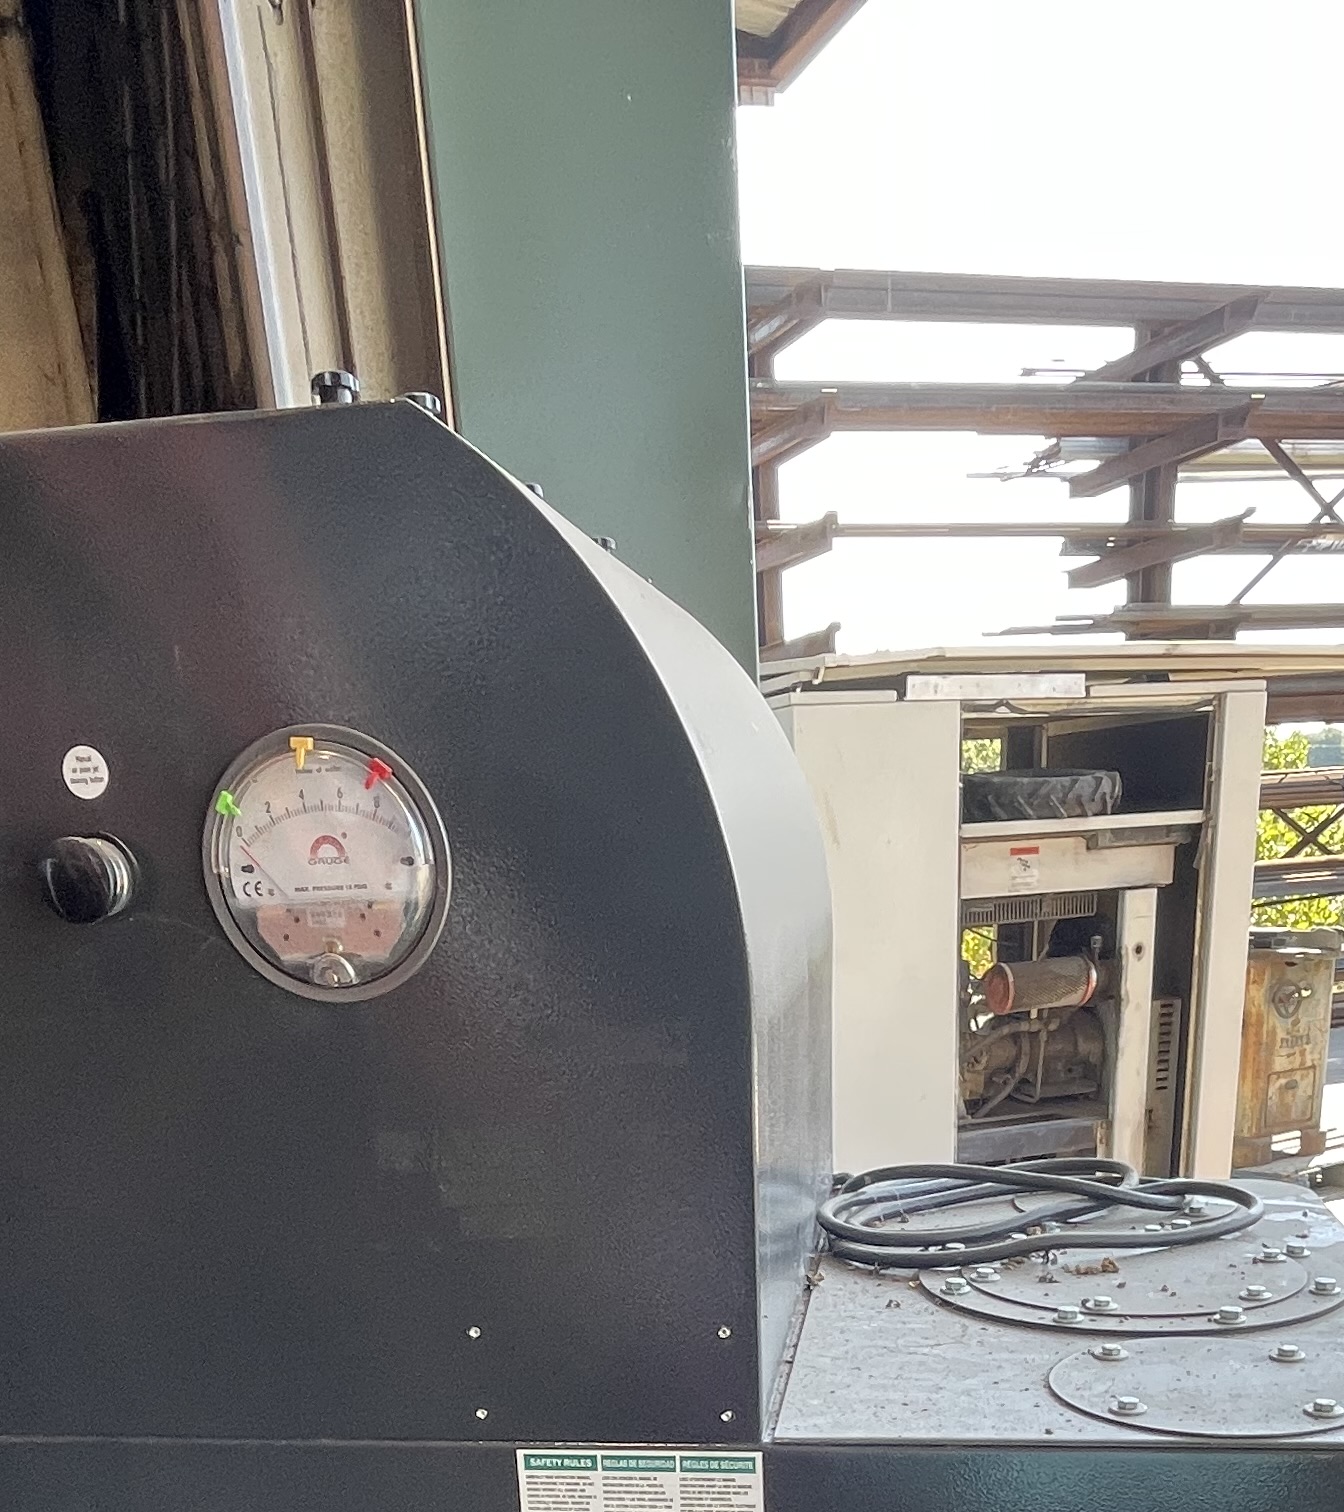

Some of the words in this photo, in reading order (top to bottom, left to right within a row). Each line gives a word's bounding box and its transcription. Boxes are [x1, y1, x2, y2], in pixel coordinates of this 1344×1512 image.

[235, 825, 244, 838] 0
[264, 801, 272, 814] 2
[298, 789, 305, 800] 4
[336, 787, 344, 799] 6
[308, 856, 351, 866] GAUGE
[529, 1458, 562, 1467] SAFETY
[563, 1458, 593, 1468] RULES
[710, 1460, 719, 1469] DE
